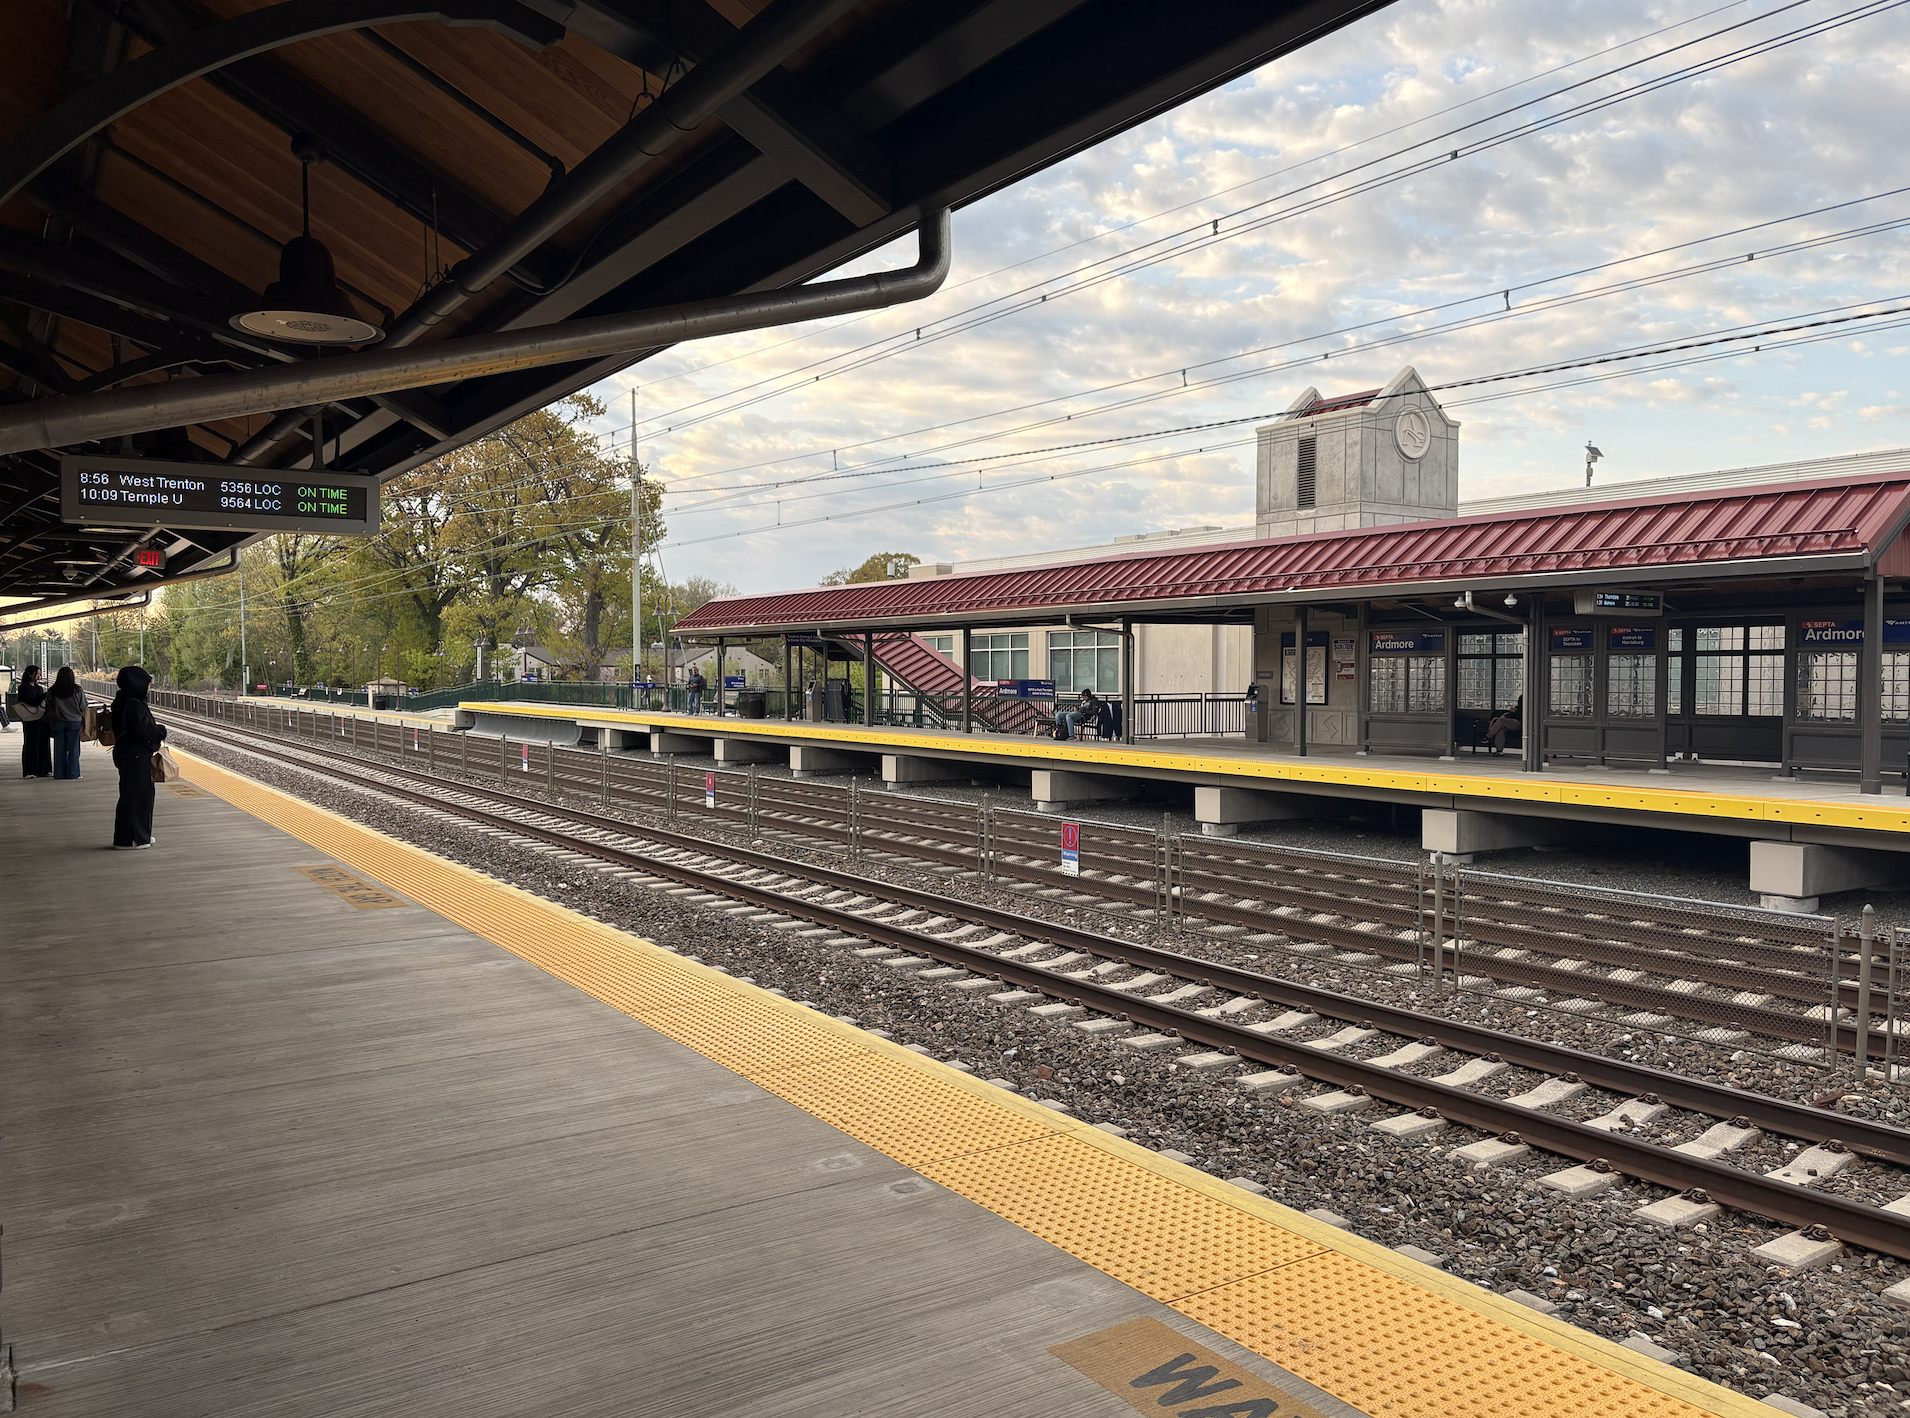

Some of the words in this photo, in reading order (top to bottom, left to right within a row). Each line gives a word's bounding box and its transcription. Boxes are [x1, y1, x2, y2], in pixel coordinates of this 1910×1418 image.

[80, 473, 109, 484] 8:56
[119, 475, 154, 487] West
[156, 477, 204, 491] Trenton
[220, 482, 252, 494] 5356
[255, 484, 281, 495] LOC
[298, 487, 316, 498] ON
[319, 488, 347, 500] TIME
[81, 488, 118, 500] 10:09
[120, 490, 168, 505] Temple
[173, 494, 182, 504] U
[220, 497, 251, 509] 9564
[255, 499, 281, 510] LOC
[298, 502, 316, 512] ON
[319, 503, 347, 514] TIME
[140, 550, 160, 565] EXIT
[1375, 640, 1414, 649] Ardmore
